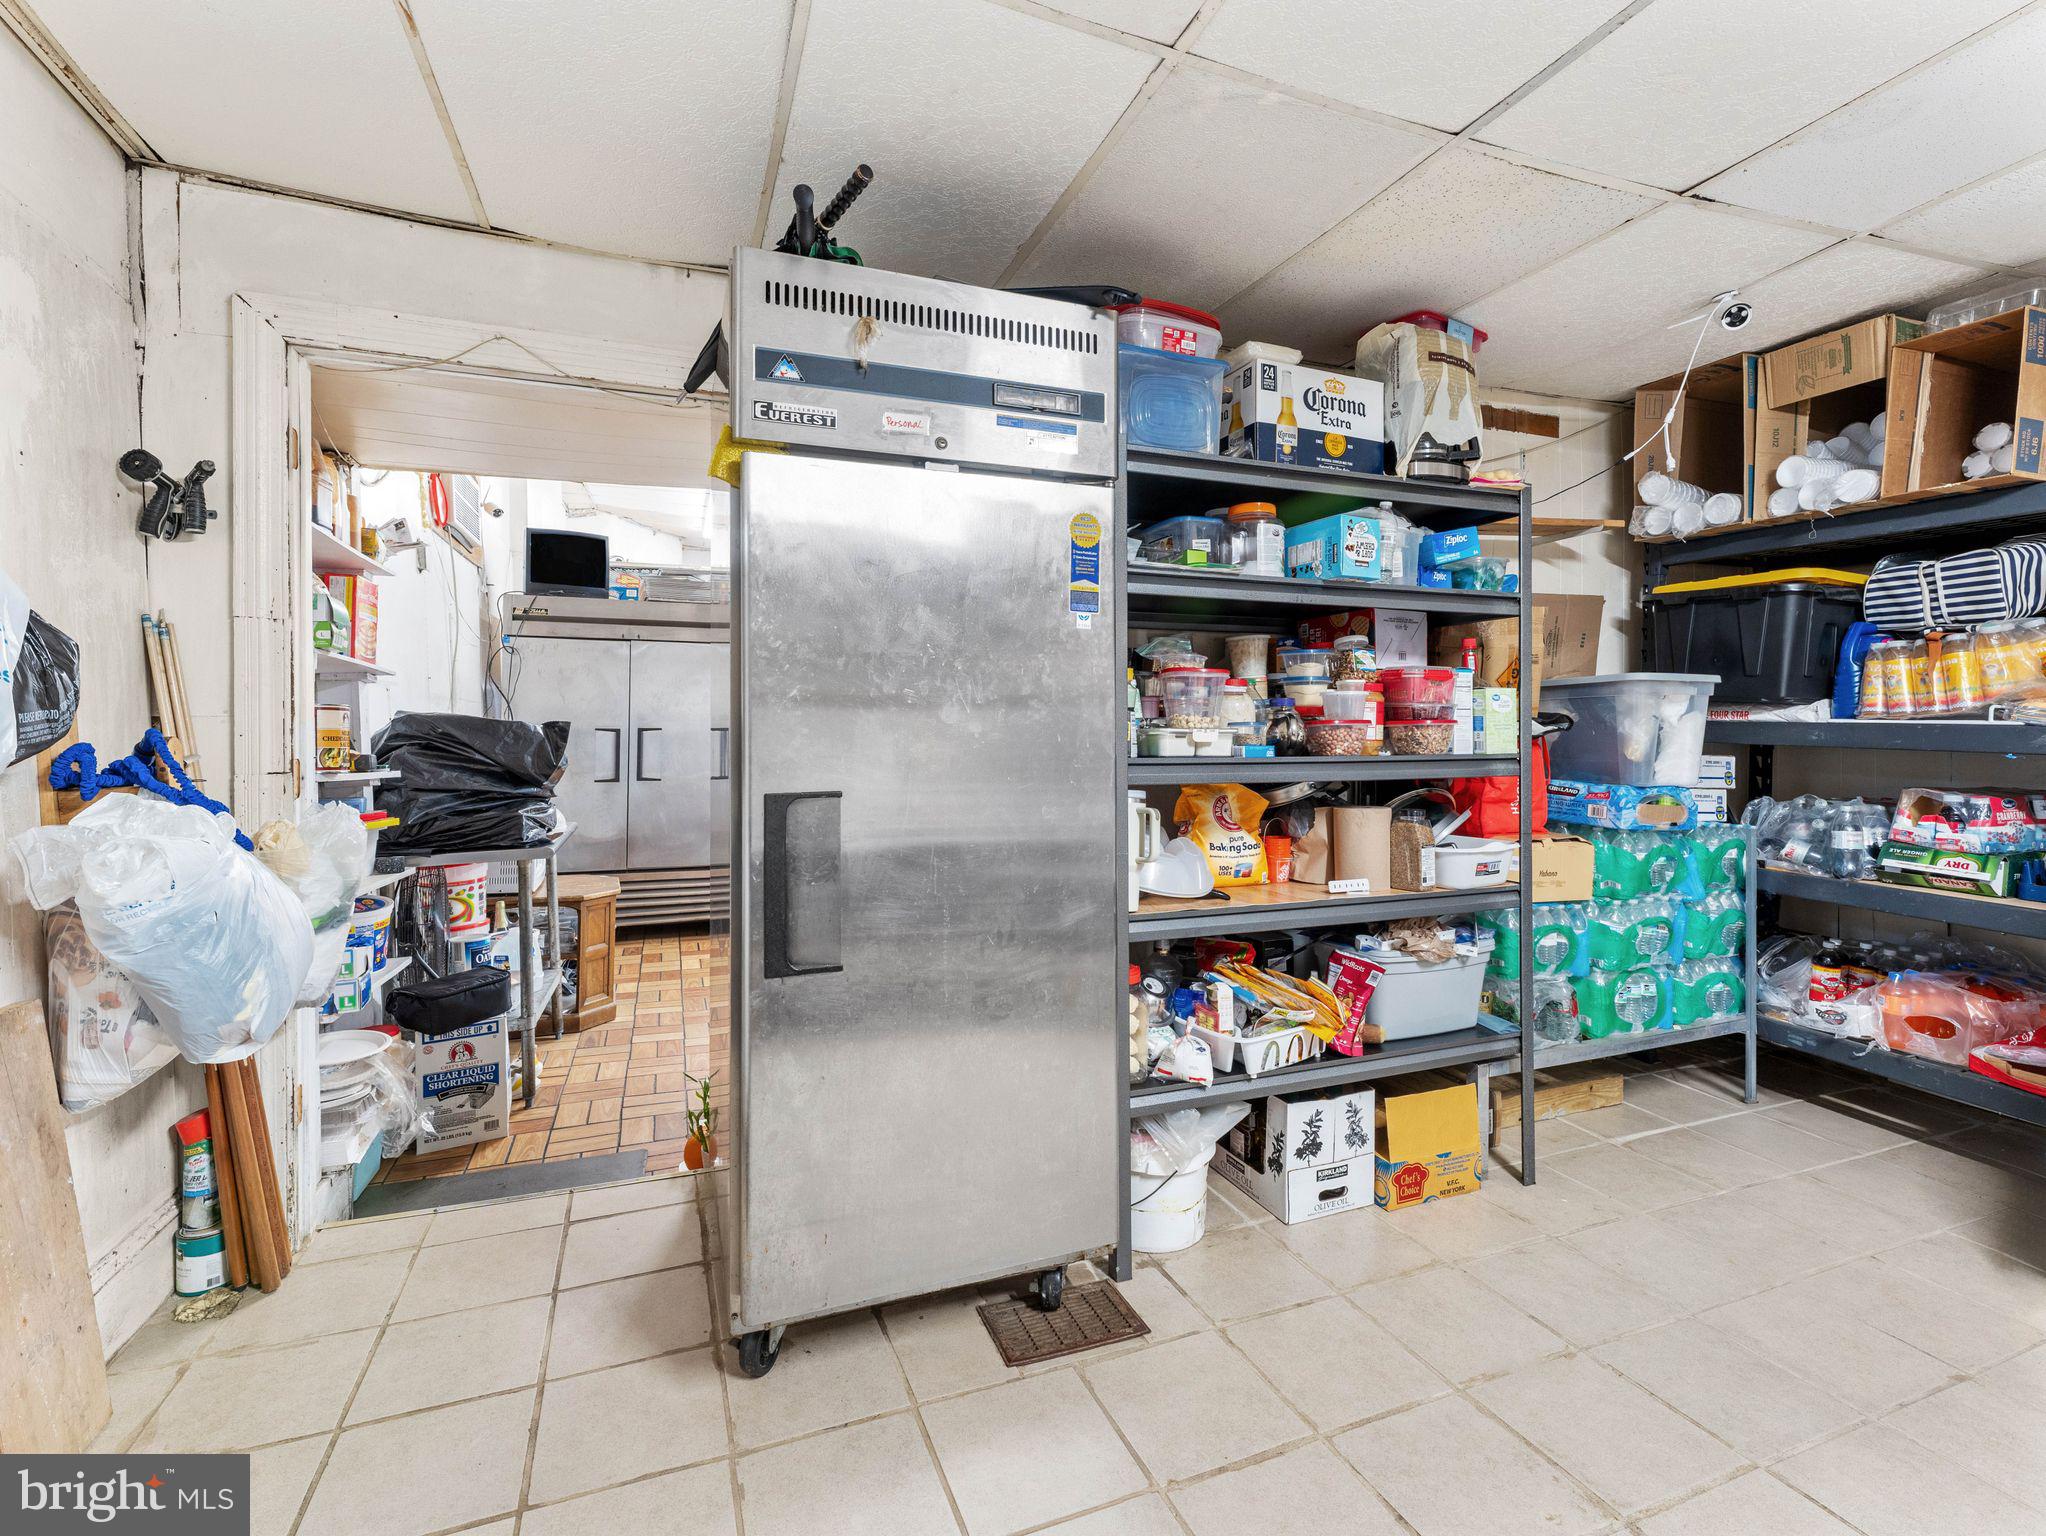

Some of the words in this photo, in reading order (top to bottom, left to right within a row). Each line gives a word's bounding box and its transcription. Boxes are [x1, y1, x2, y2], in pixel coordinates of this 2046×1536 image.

[1264, 366, 1275, 379] 24
[1303, 386, 1366, 417] Corona
[886, 416, 923, 429] Personal
[1321, 410, 1352, 430] Extra
[1446, 535, 1468, 546] Ziploc
[1710, 710, 1729, 719] FOUR
[1730, 710, 1750, 719] STAR
[1229, 835, 1244, 843] pure
[1209, 842, 1242, 853] Baking
[1903, 848, 1928, 857] GINGER
[1944, 860, 1970, 870] DRY
[344, 997, 352, 1007] L
[457, 1027, 472, 1037] SIDE
[474, 1025, 483, 1034] UP
[426, 1071, 459, 1083] CLEAR
[460, 1065, 496, 1078] LIQUID
[428, 1073, 494, 1091] SHORTENING
[1221, 1160, 1242, 1180] OLIVE
[1241, 1177, 1254, 1190] OIL
[1317, 1165, 1348, 1178] KIRKLAND
[1400, 1171, 1421, 1185] Chef's
[1400, 1184, 1420, 1197] Choice
[1440, 1188, 1451, 1196] NEW
[1451, 1185, 1466, 1194] YORK
[1313, 1201, 1336, 1212] OLIVE
[1336, 1198, 1349, 1206] OIL
